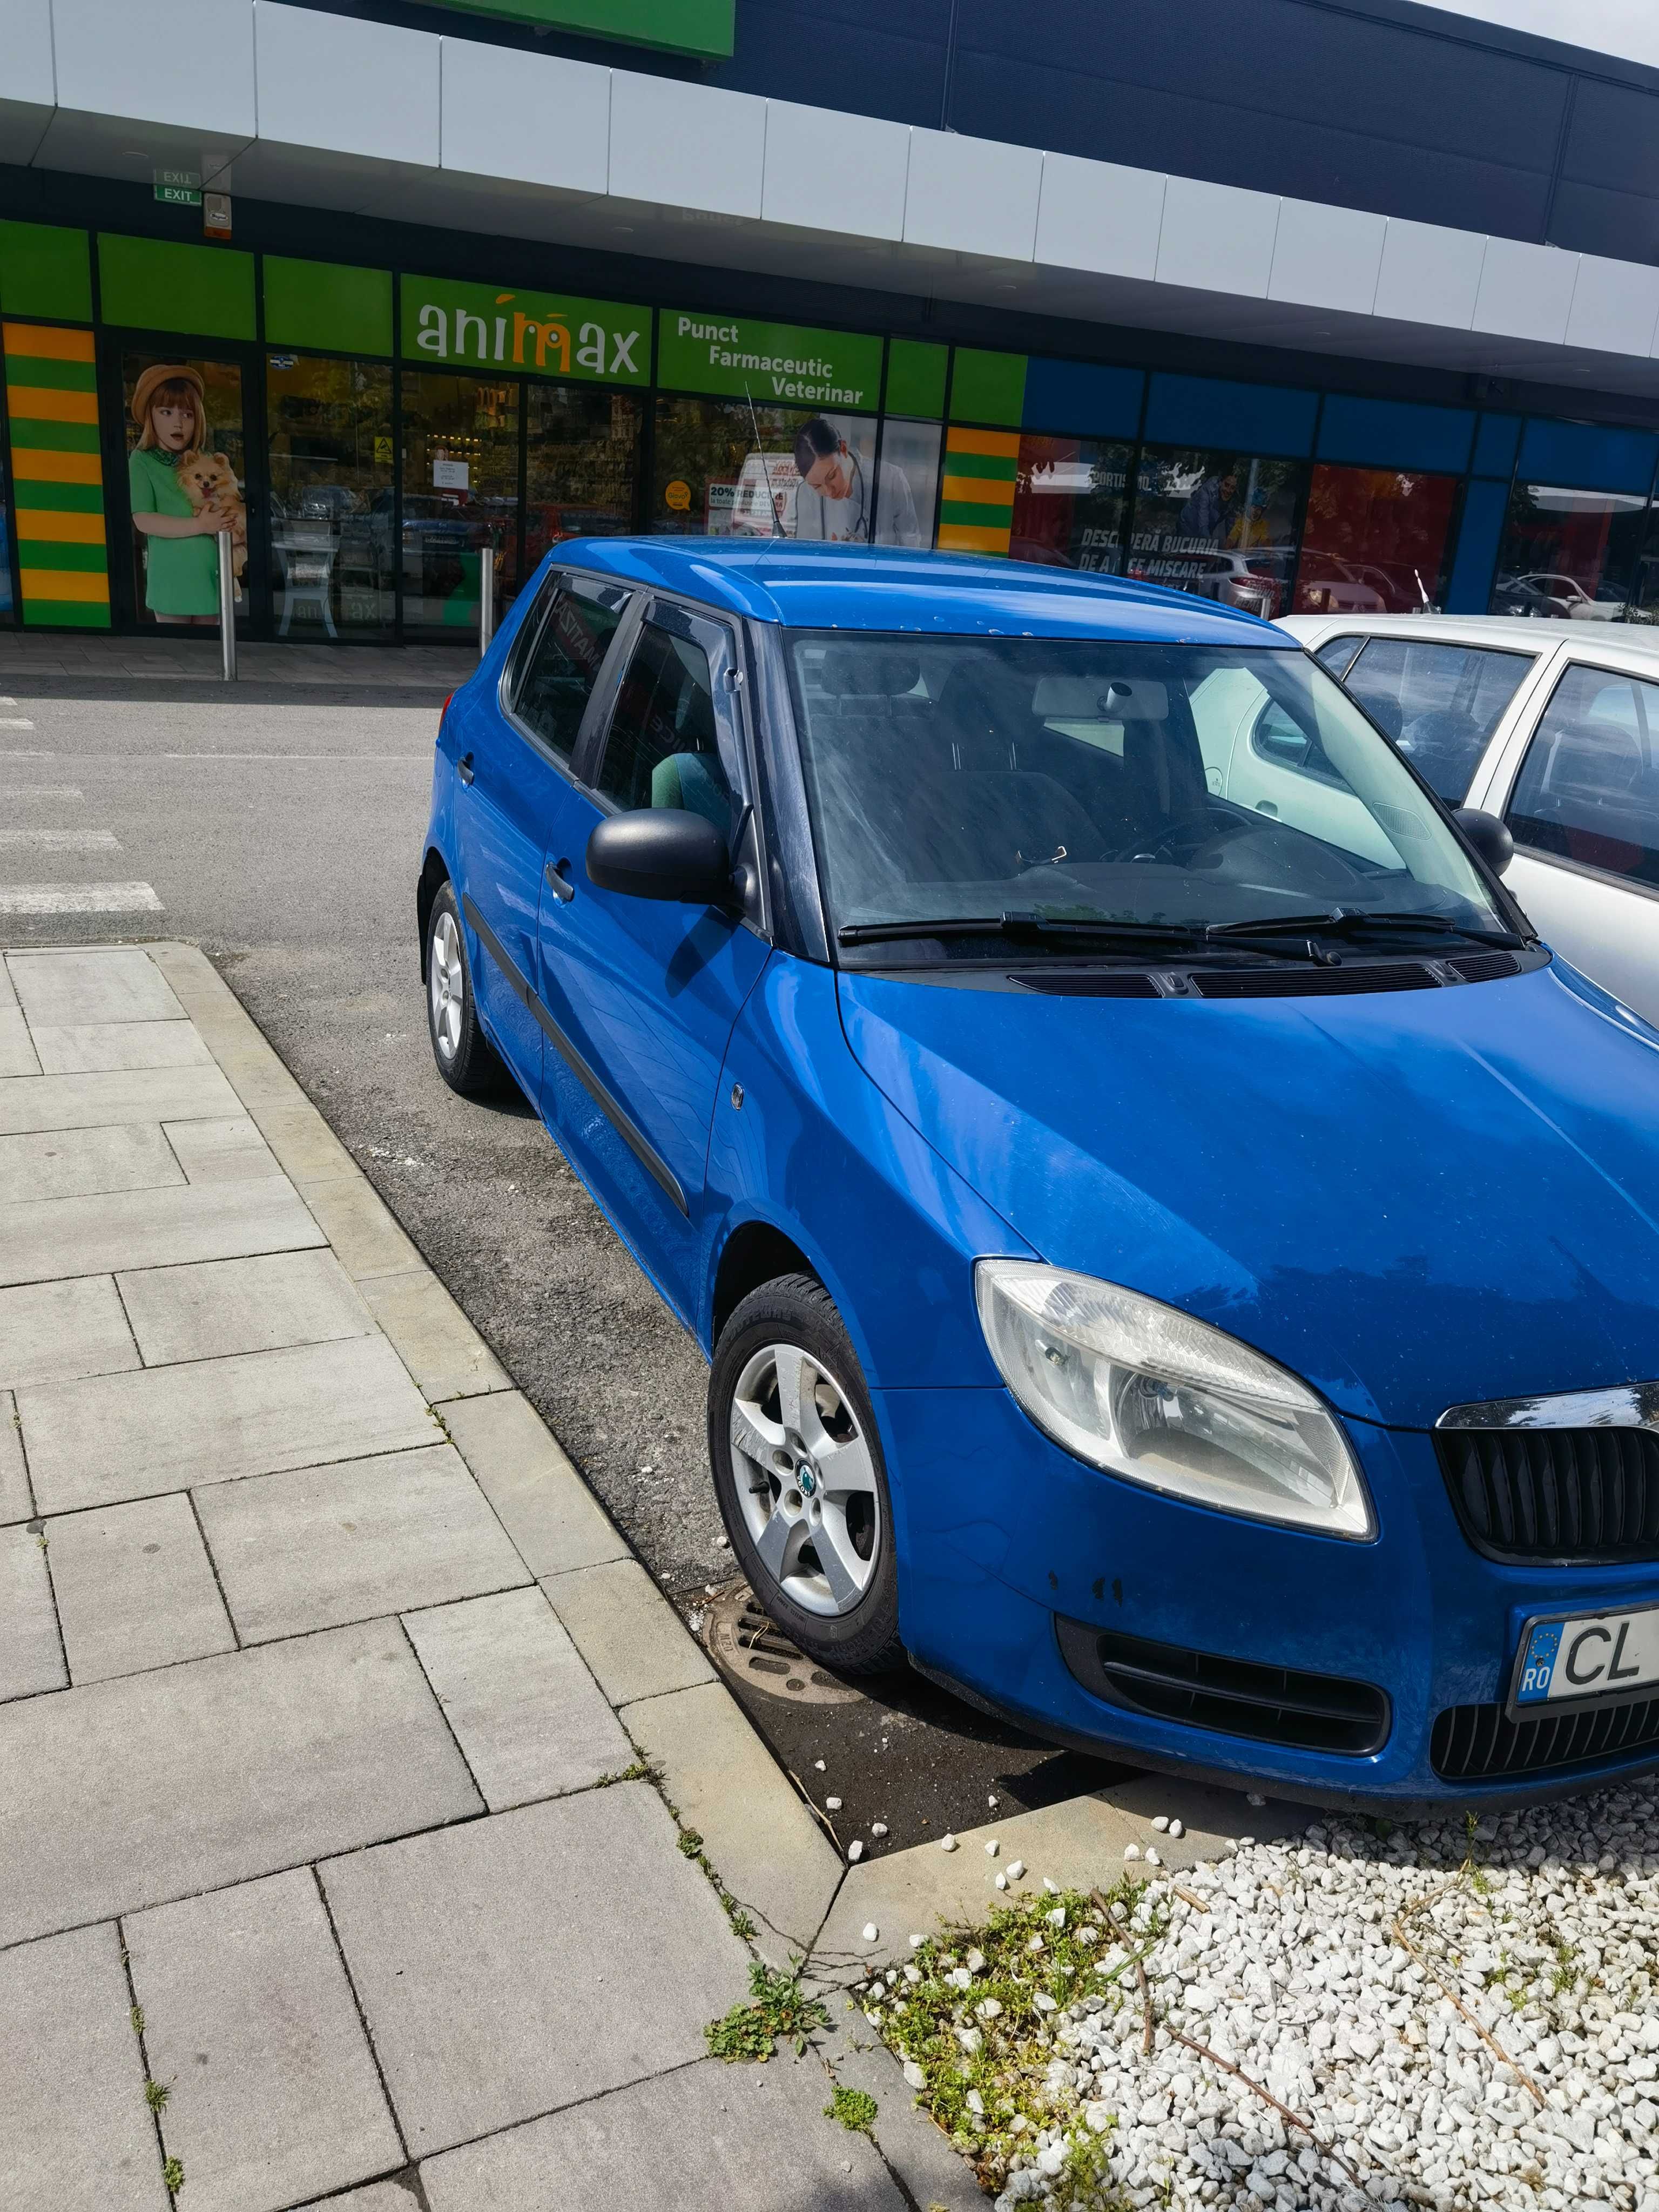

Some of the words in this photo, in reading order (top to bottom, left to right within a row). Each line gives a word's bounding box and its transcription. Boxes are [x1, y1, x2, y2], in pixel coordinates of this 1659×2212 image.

[164, 188, 193, 201] EXIT
[417, 293, 640, 374] animax
[678, 317, 739, 343] Punct
[709, 345, 833, 379] Farmaceutic
[771, 376, 864, 404] Veterinar
[711, 487, 735, 497] 20%
[1082, 528, 1163, 552] DESCERĂ
[1162, 535, 1219, 555] BUCURIA
[1079, 553, 1099, 571] DE
[1098, 555, 1110, 572] A
[1522, 1666, 1550, 1692] RO
[1565, 1620, 1640, 1685] CL
